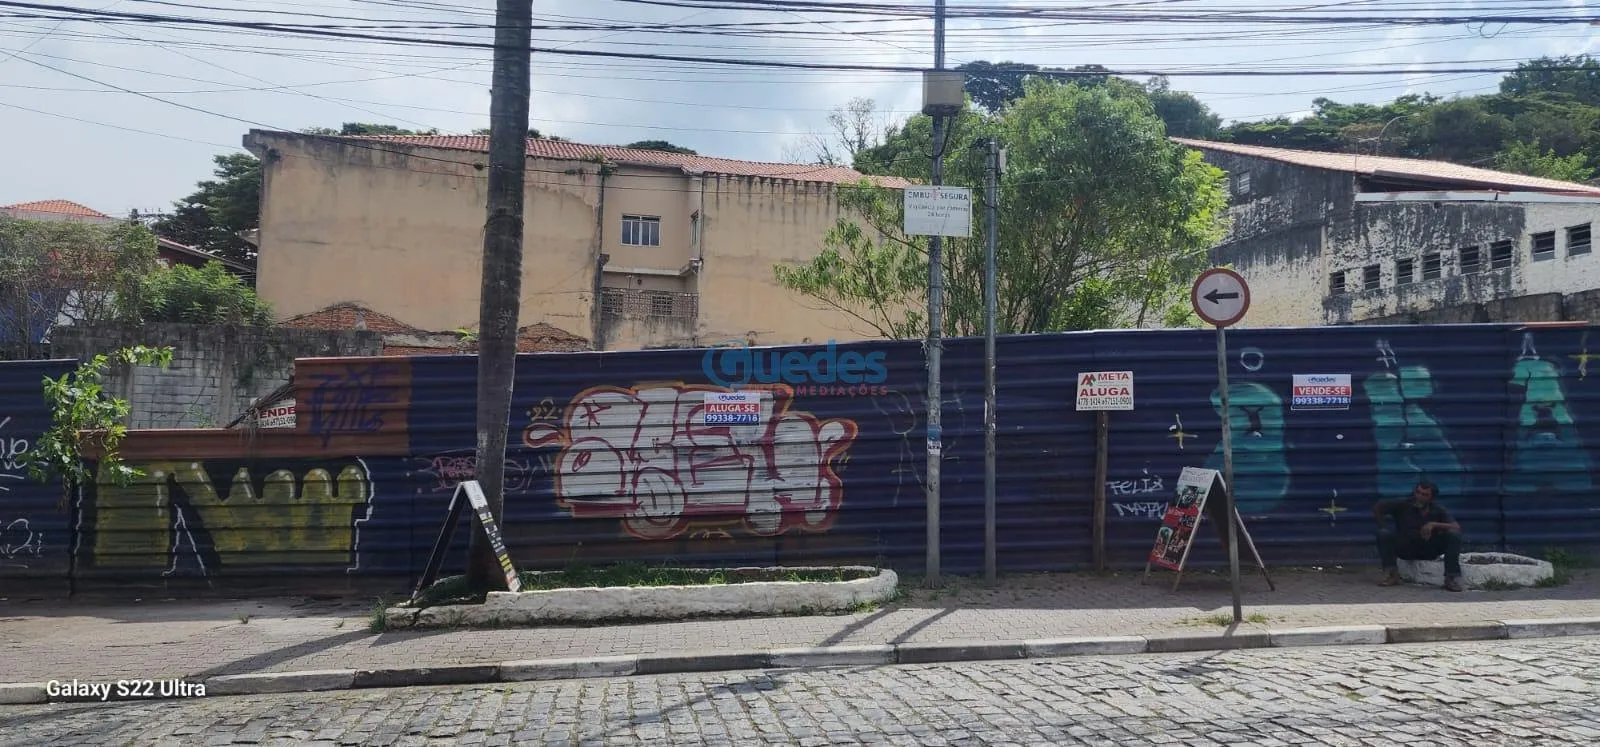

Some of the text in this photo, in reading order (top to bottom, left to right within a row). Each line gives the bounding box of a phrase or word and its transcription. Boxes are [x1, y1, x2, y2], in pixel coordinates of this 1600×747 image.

[940, 192, 969, 201] SEGURA
[1098, 373, 1129, 381] META
[1080, 387, 1130, 397] ALUGA
[1298, 386, 1346, 396] VENDE-SE
[1295, 396, 1349, 405] 99338-7718
[259, 406, 297, 419] ENDE
[709, 404, 755, 413] ALUGA-SE
[706, 414, 758, 422] 99338-7718
